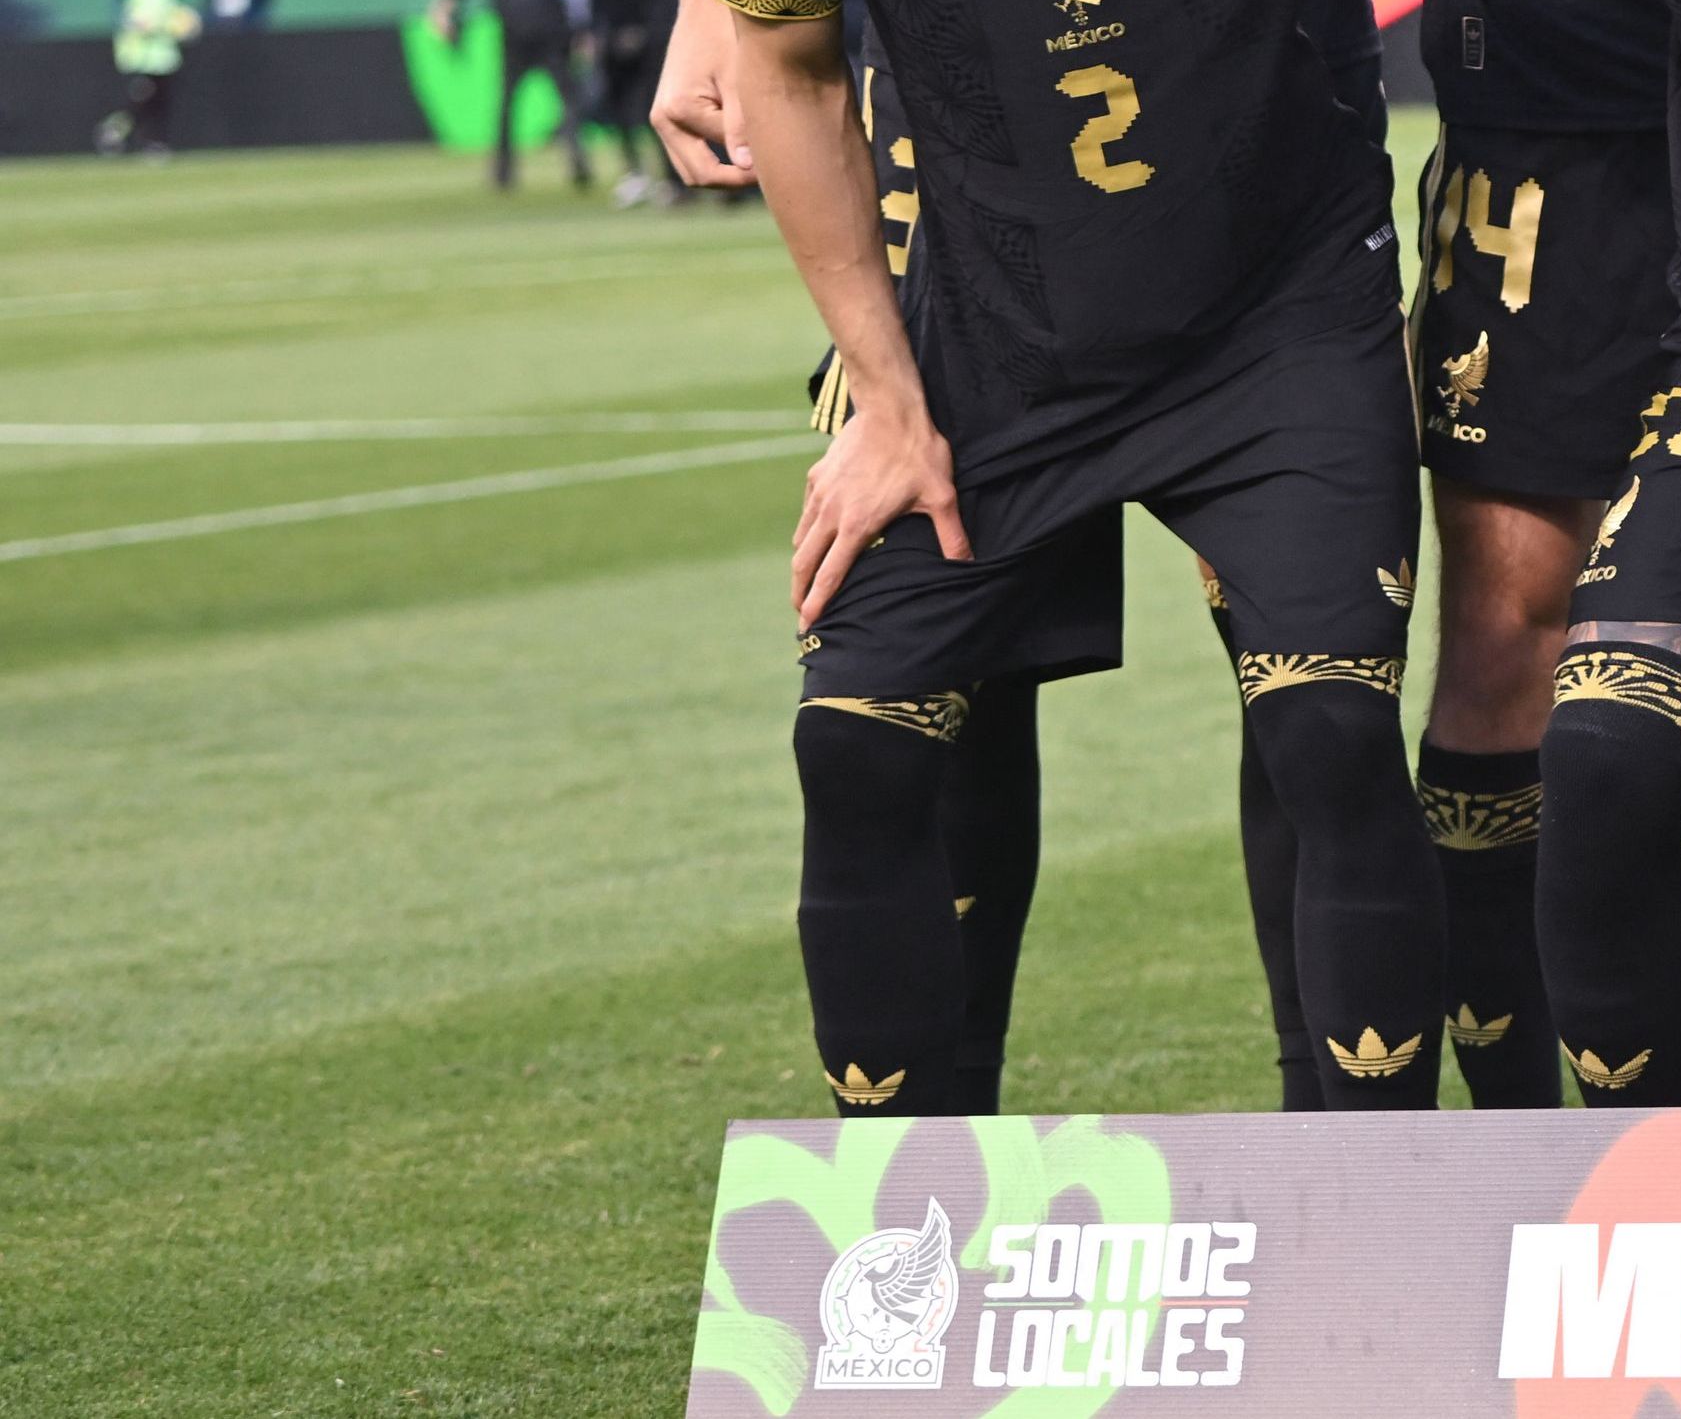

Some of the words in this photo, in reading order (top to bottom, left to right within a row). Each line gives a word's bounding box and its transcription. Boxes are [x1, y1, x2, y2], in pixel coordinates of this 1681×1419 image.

[1045, 21, 1126, 54] MÉXICO
[1055, 64, 1156, 194] 2
[826, 1353, 933, 1379] MÉXICO
[973, 1308, 1246, 1387] LOCALES
